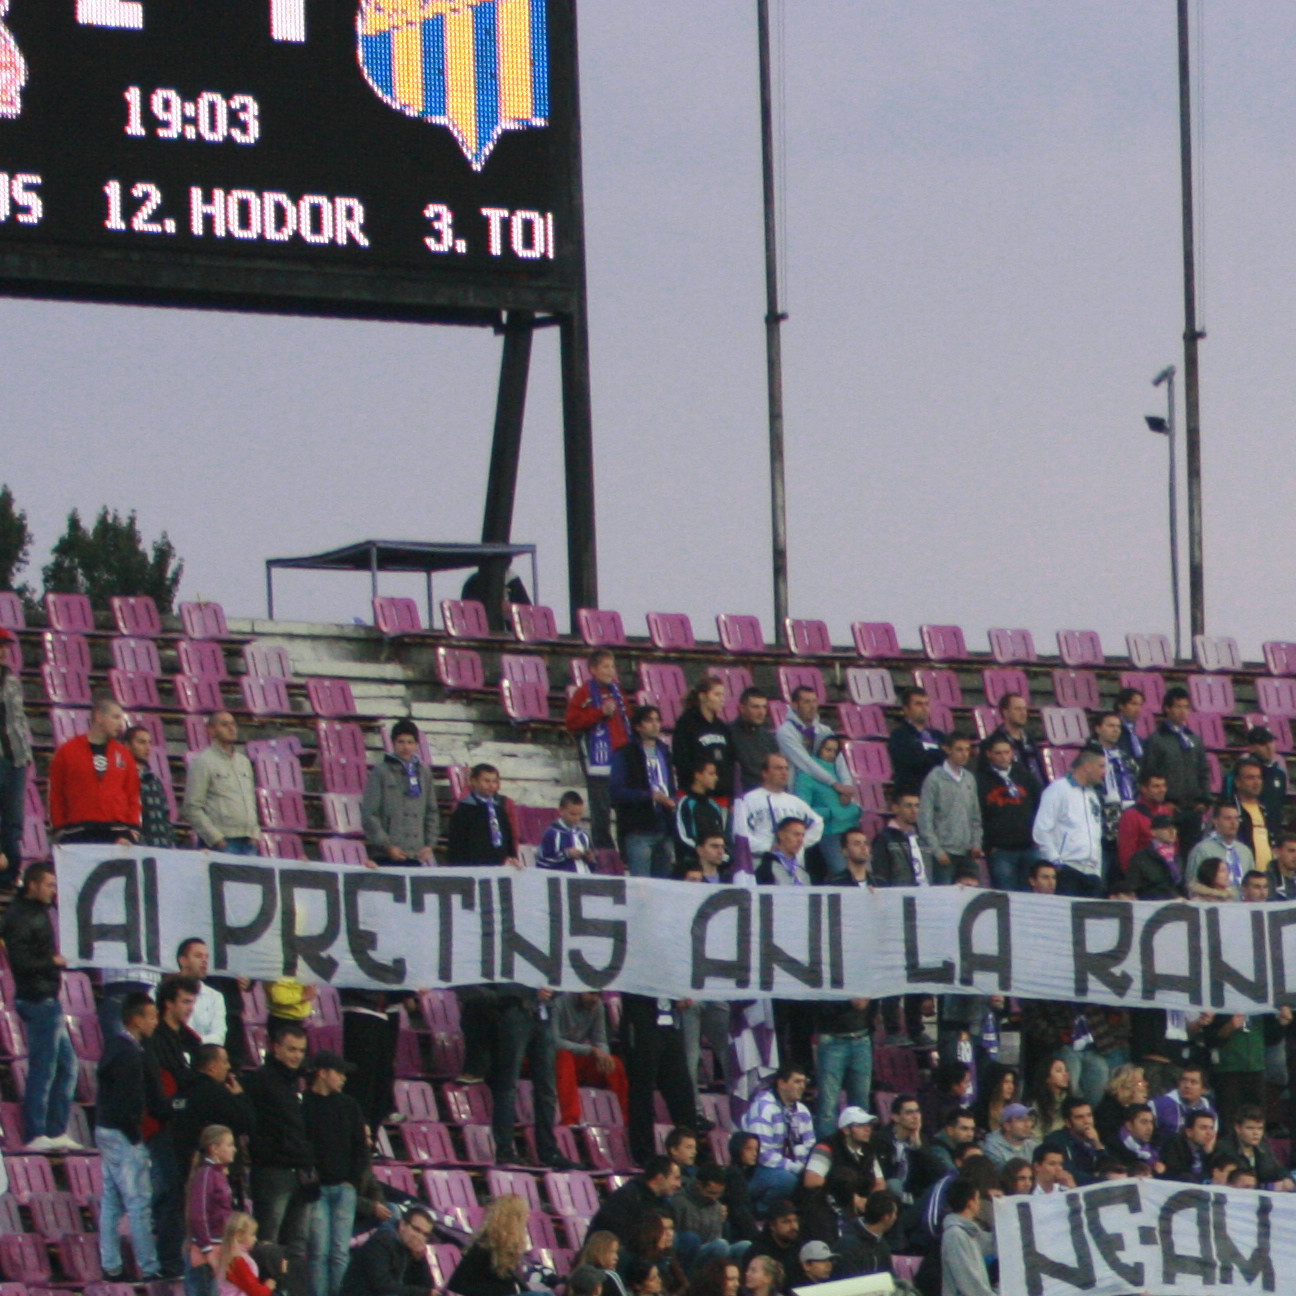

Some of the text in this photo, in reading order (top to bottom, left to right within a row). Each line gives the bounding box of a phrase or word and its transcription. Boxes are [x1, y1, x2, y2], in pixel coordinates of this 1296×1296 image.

[124, 86, 259, 144] 19:03
[0, 173, 554, 259] S 12. HODOR 3. TO
[77, 857, 160, 966] AI
[209, 863, 627, 988] PRETINS
[692, 889, 845, 991] ANI
[904, 892, 1012, 990] LA
